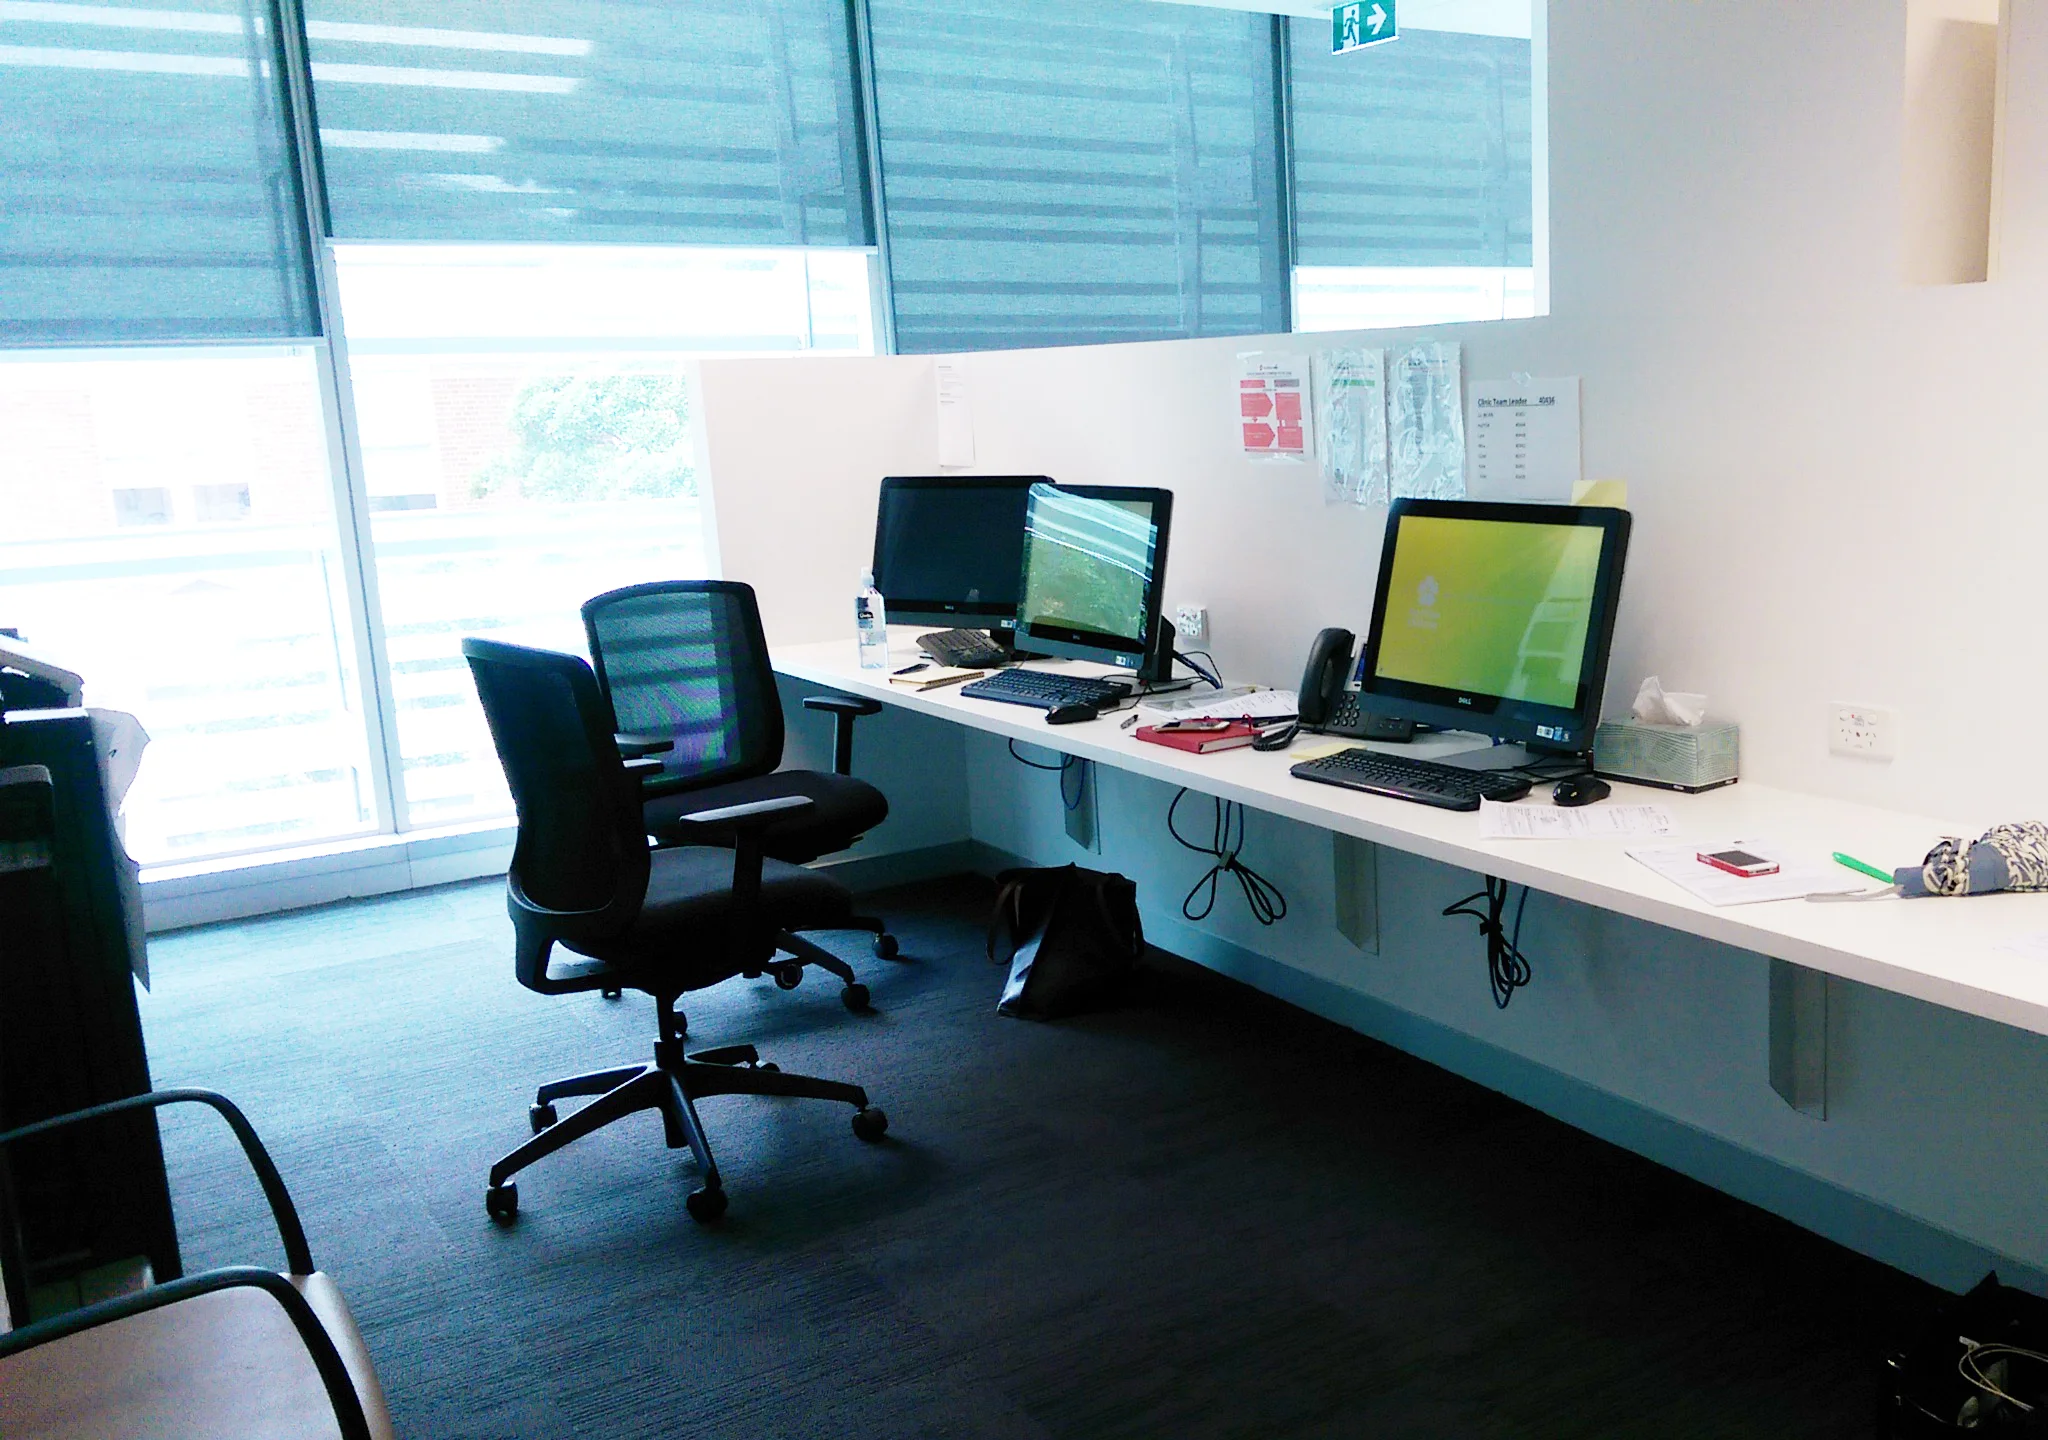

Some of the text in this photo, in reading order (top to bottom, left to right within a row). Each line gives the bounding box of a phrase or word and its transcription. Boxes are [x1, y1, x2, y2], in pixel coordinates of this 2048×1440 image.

[1477, 398, 1492, 406] Clinic
[1493, 398, 1507, 406] Team
[1508, 397, 1527, 406] Leader
